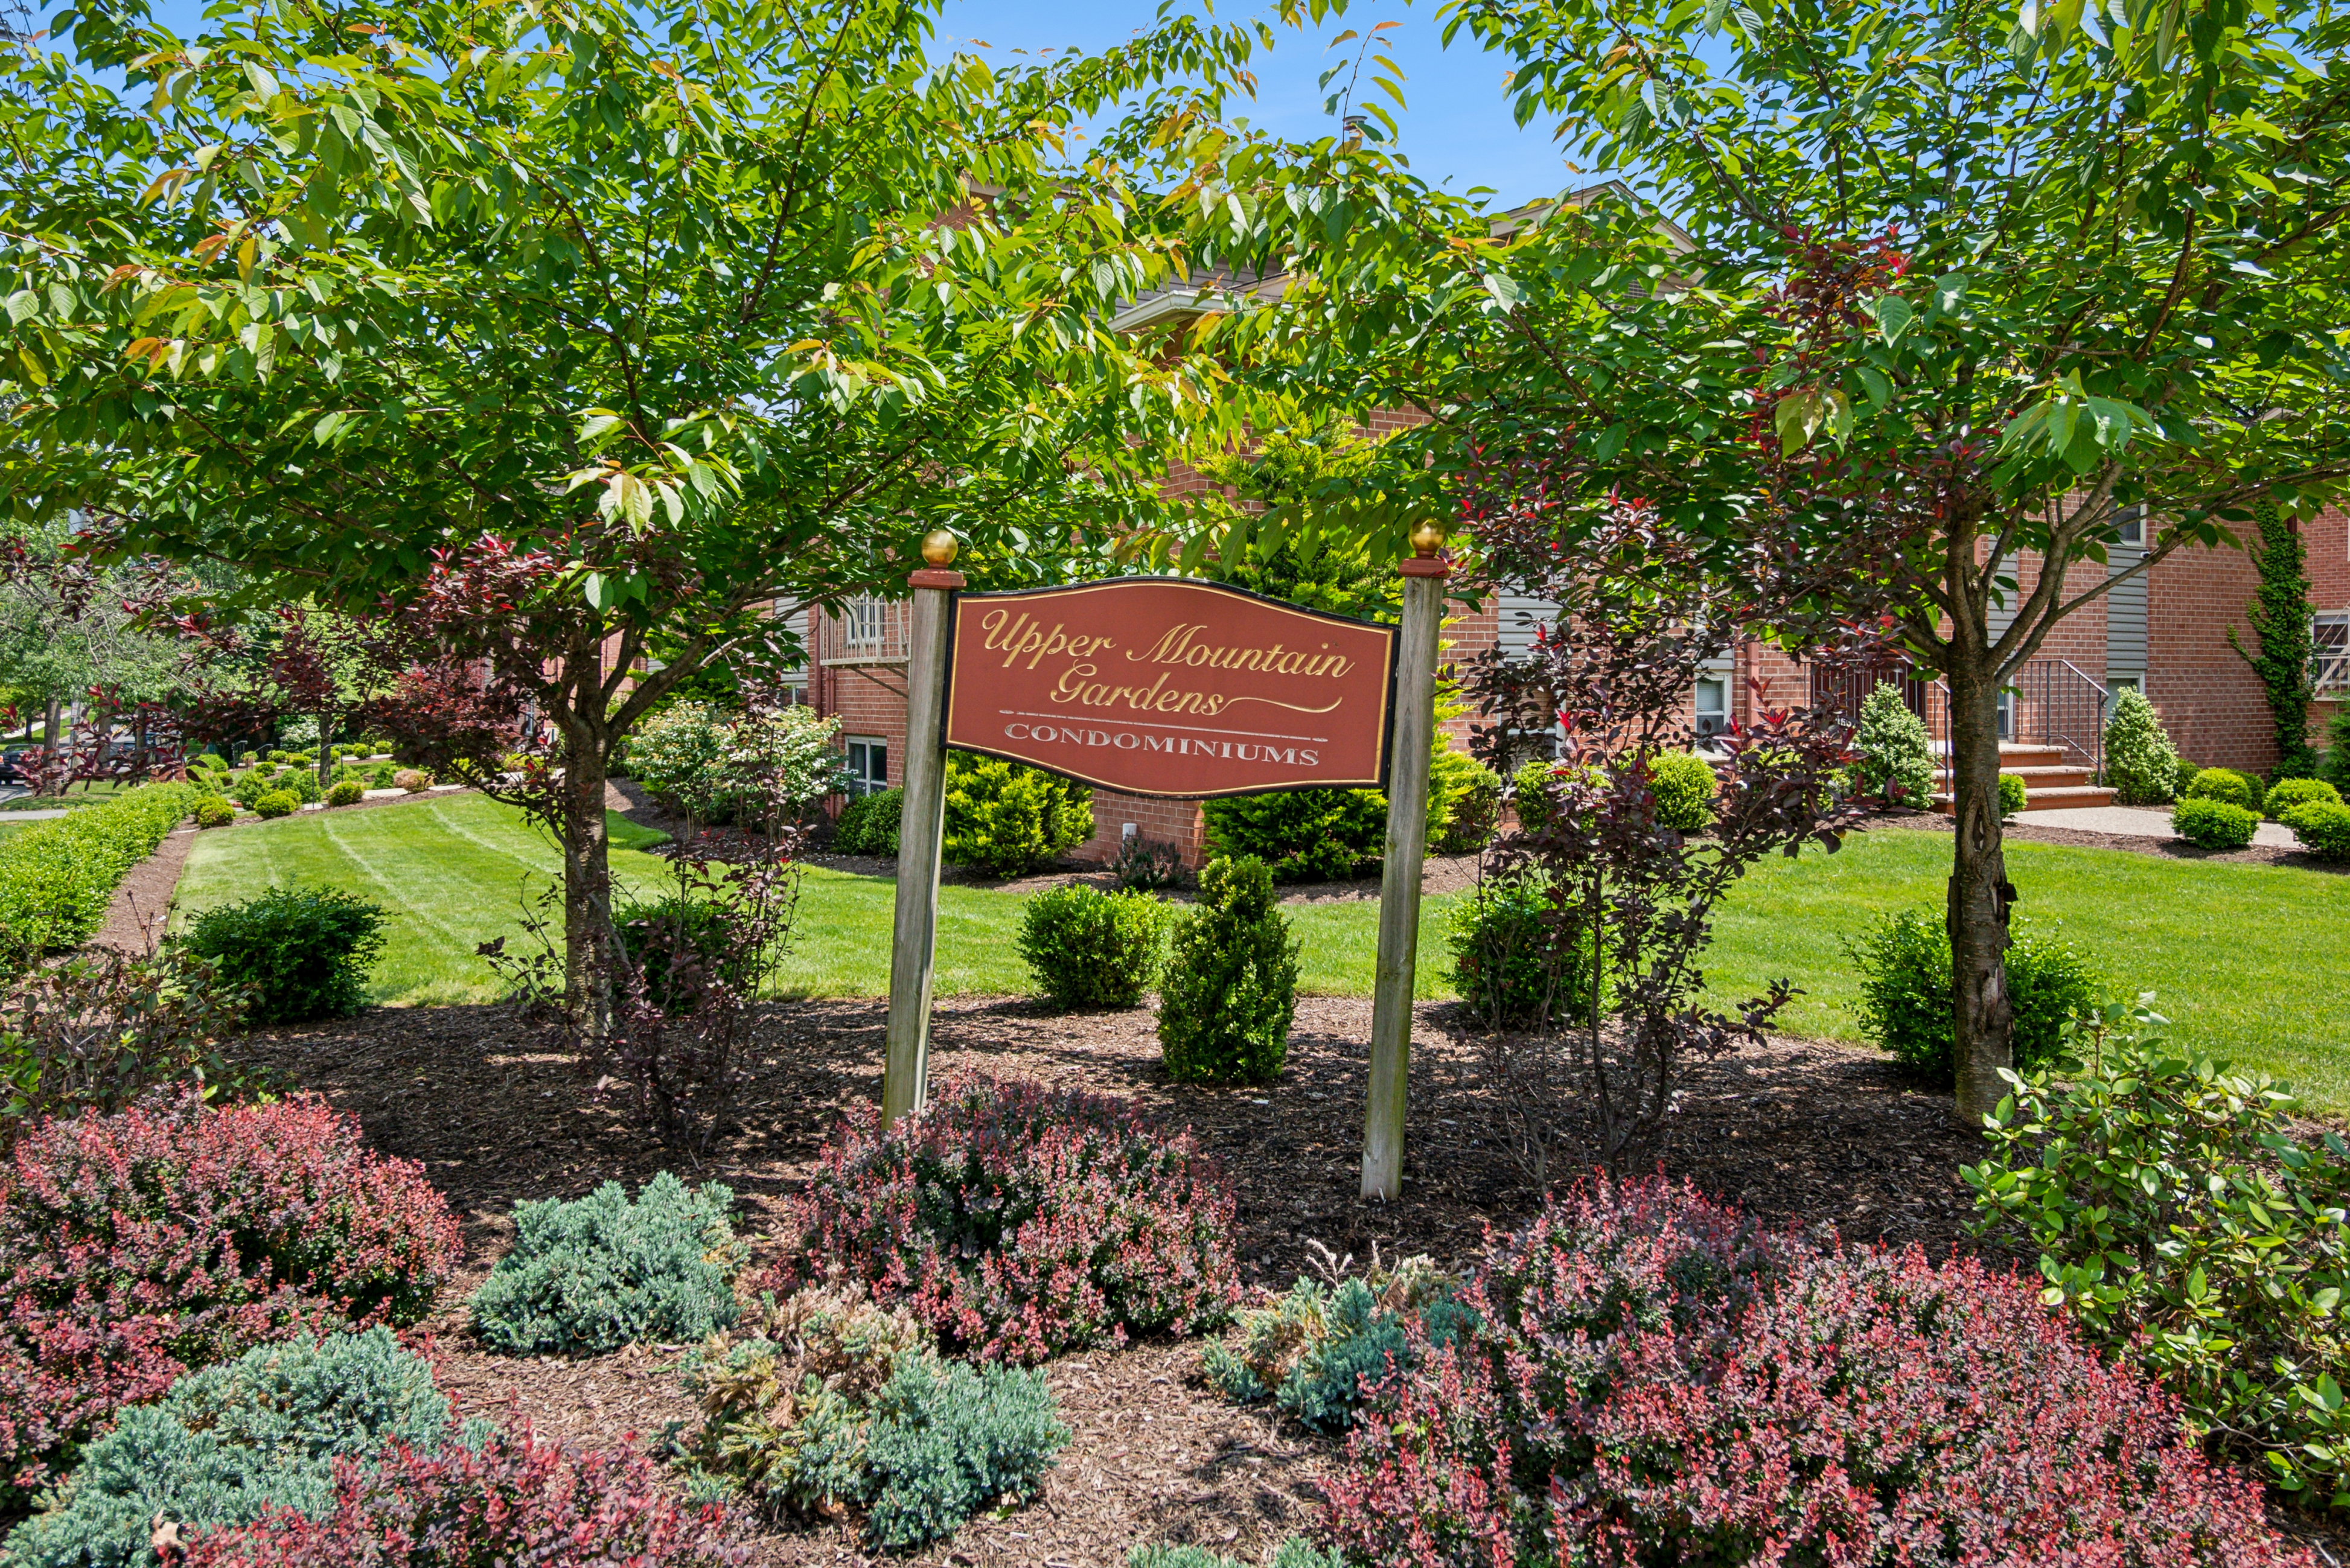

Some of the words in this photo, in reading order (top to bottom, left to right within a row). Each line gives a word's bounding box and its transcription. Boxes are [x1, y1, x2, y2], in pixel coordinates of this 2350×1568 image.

[982, 609, 1117, 670] Upper
[1126, 623, 1356, 678] Mountain
[1050, 658, 1231, 715] Gardens
[1004, 723, 1319, 766] CONDOMINIUMS
